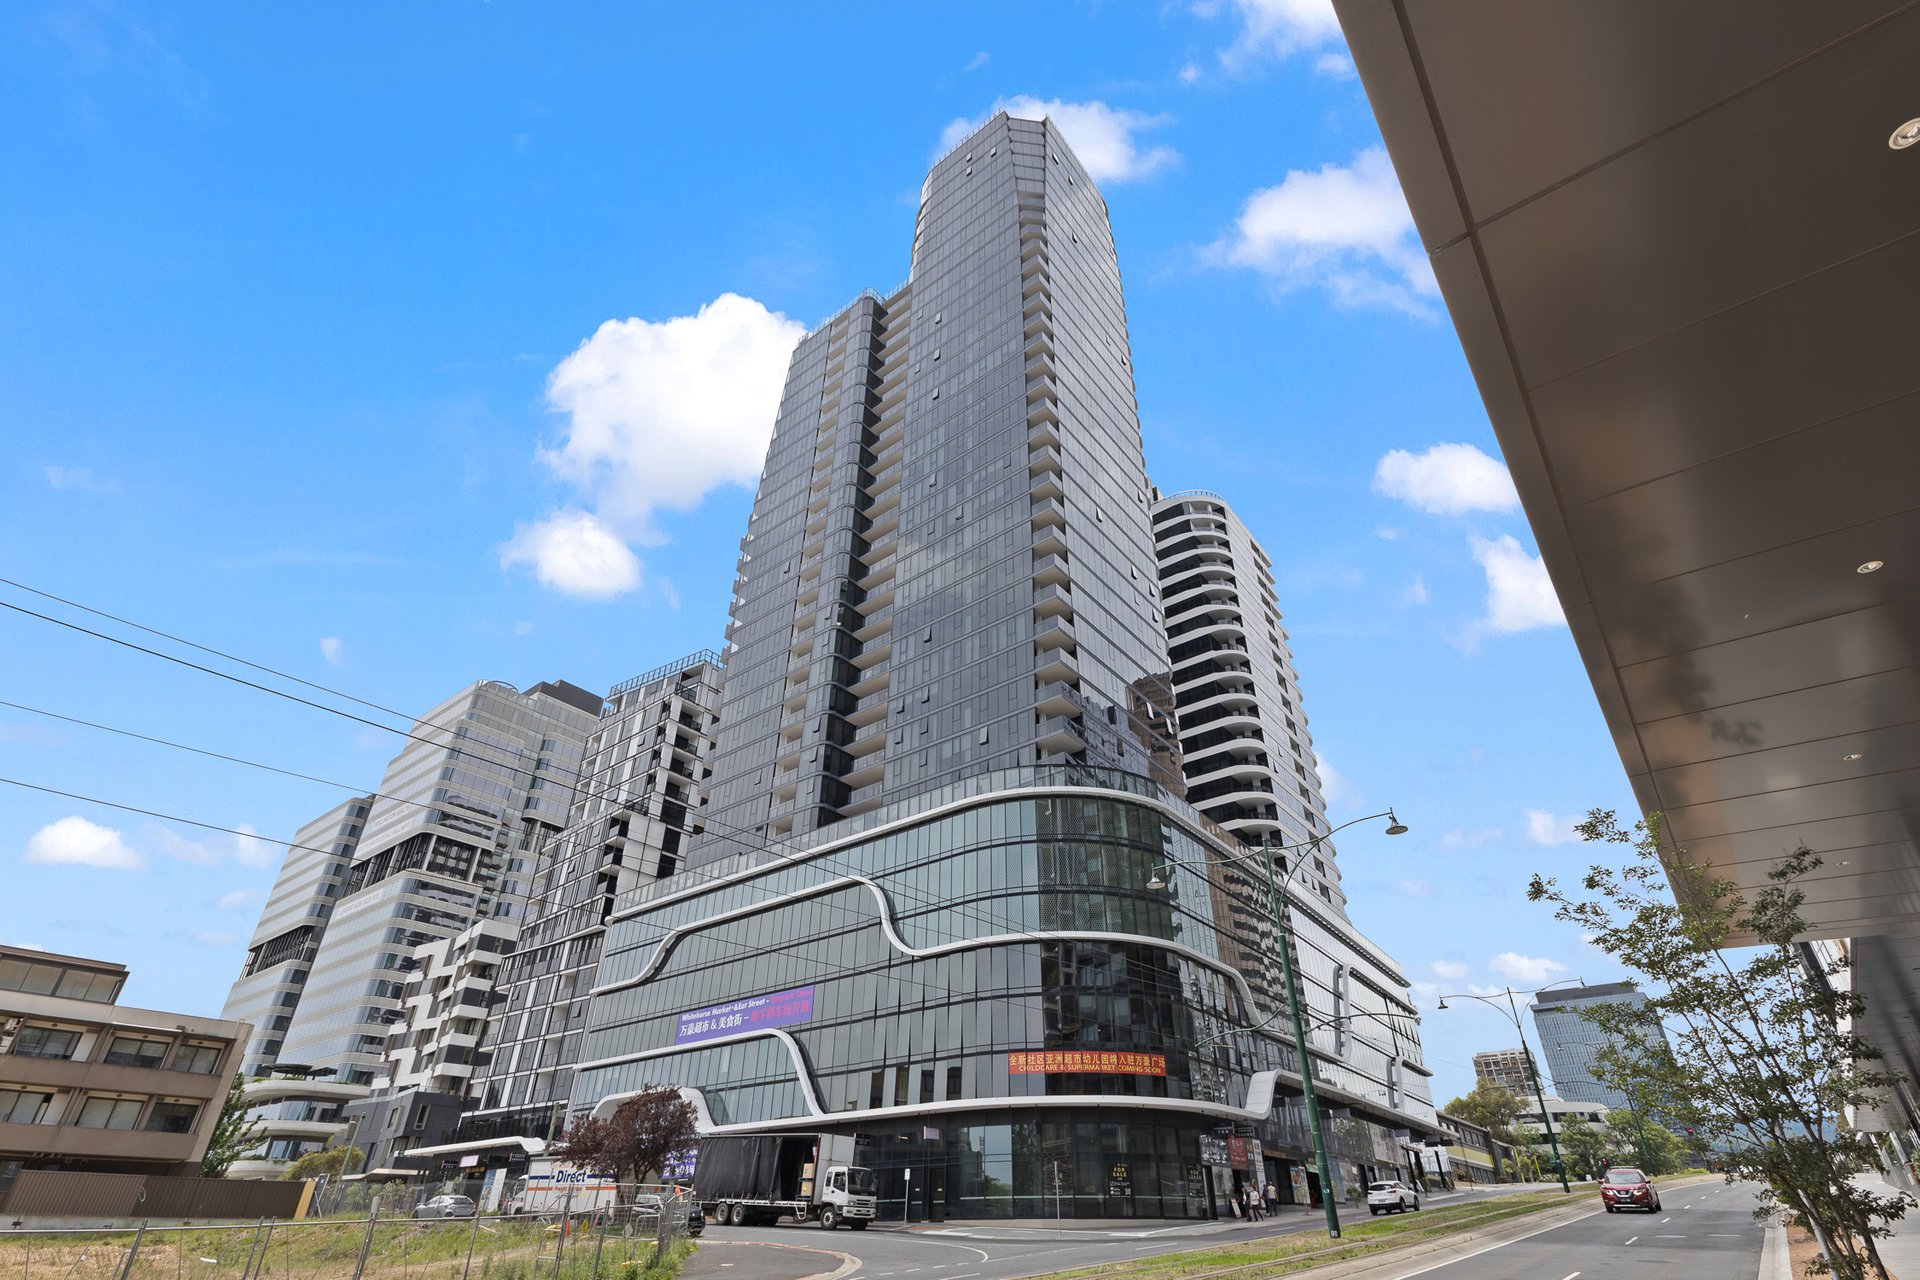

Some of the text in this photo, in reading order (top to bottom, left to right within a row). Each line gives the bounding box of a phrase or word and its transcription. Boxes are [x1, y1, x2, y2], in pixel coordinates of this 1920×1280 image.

[682, 1010, 711, 1022] Whitehorse
[748, 998, 765, 1009] Street
[717, 1013, 743, 1030] 美食街
[1018, 1064, 1058, 1072] CHILDCARE
[1067, 1064, 1116, 1072] SUPERMARKET
[1118, 1065, 1143, 1073] COMING
[555, 1169, 587, 1183] Direct
